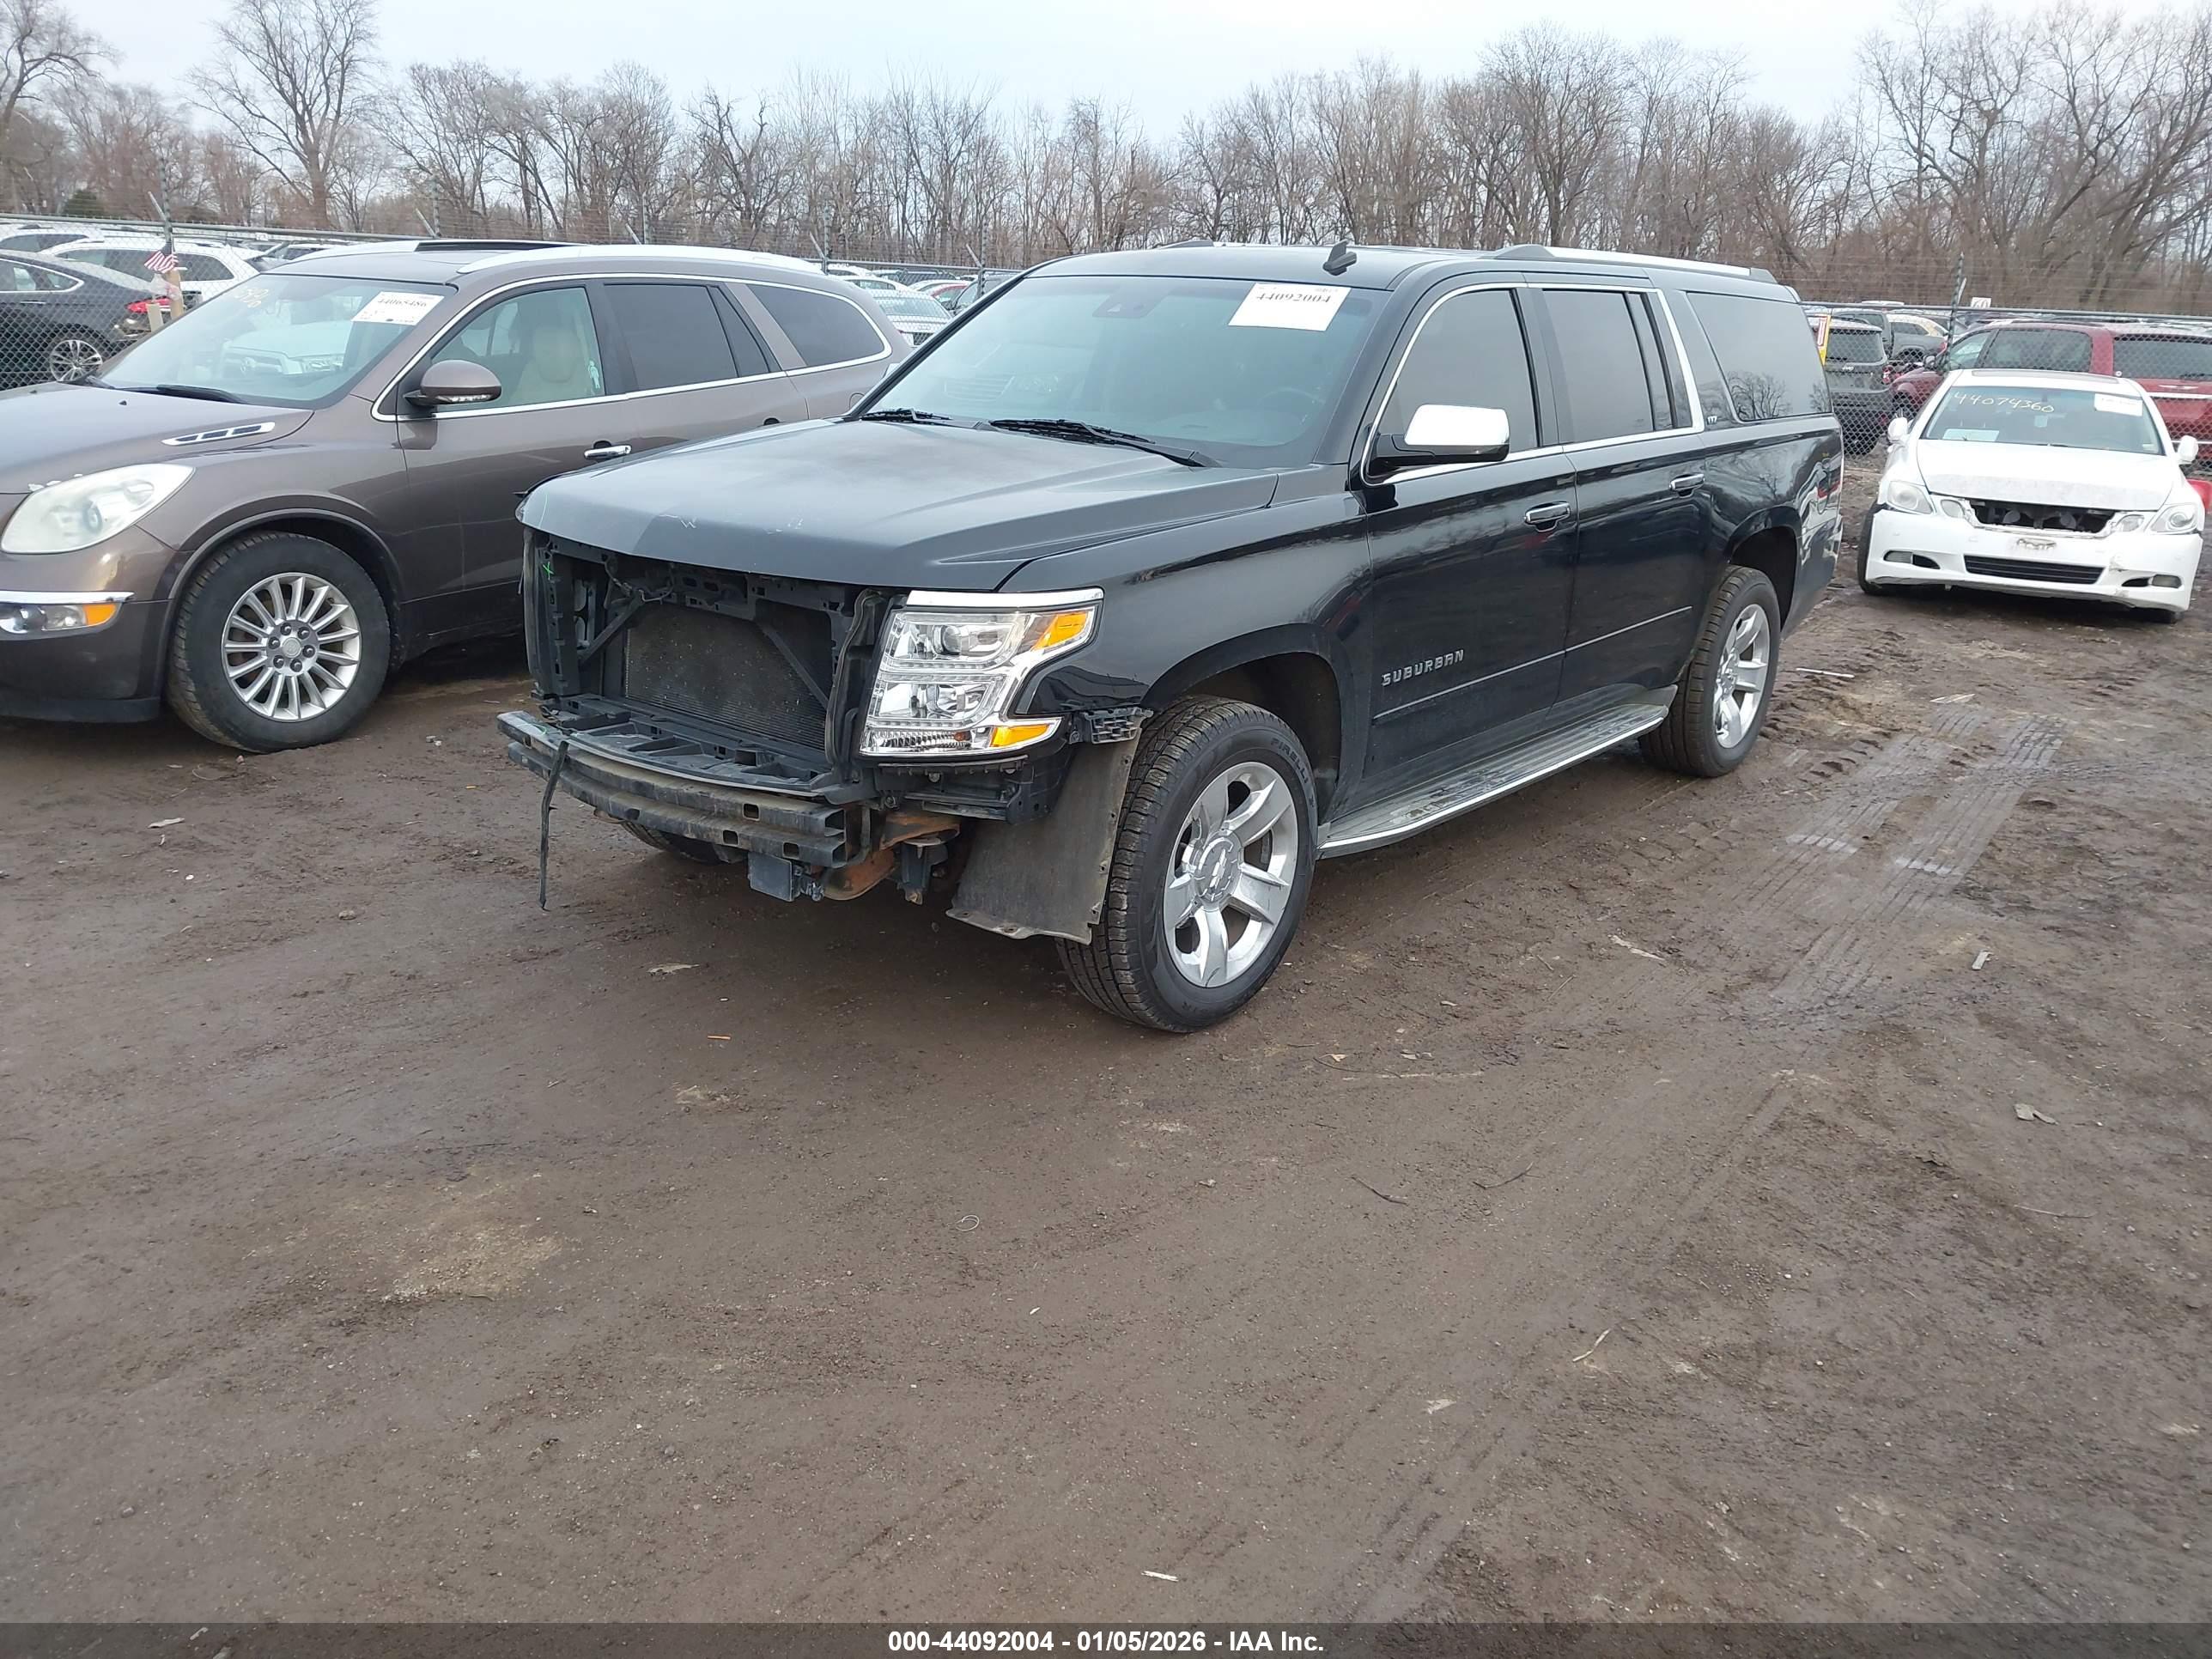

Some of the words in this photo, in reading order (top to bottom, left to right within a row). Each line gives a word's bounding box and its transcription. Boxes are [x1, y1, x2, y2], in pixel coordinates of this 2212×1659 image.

[1255, 292, 1333, 303] 44092004
[1954, 391, 2055, 413] 44074360
[1381, 649, 1464, 687] SUBURBAN
[1271, 737, 1310, 784] PIRELLI
